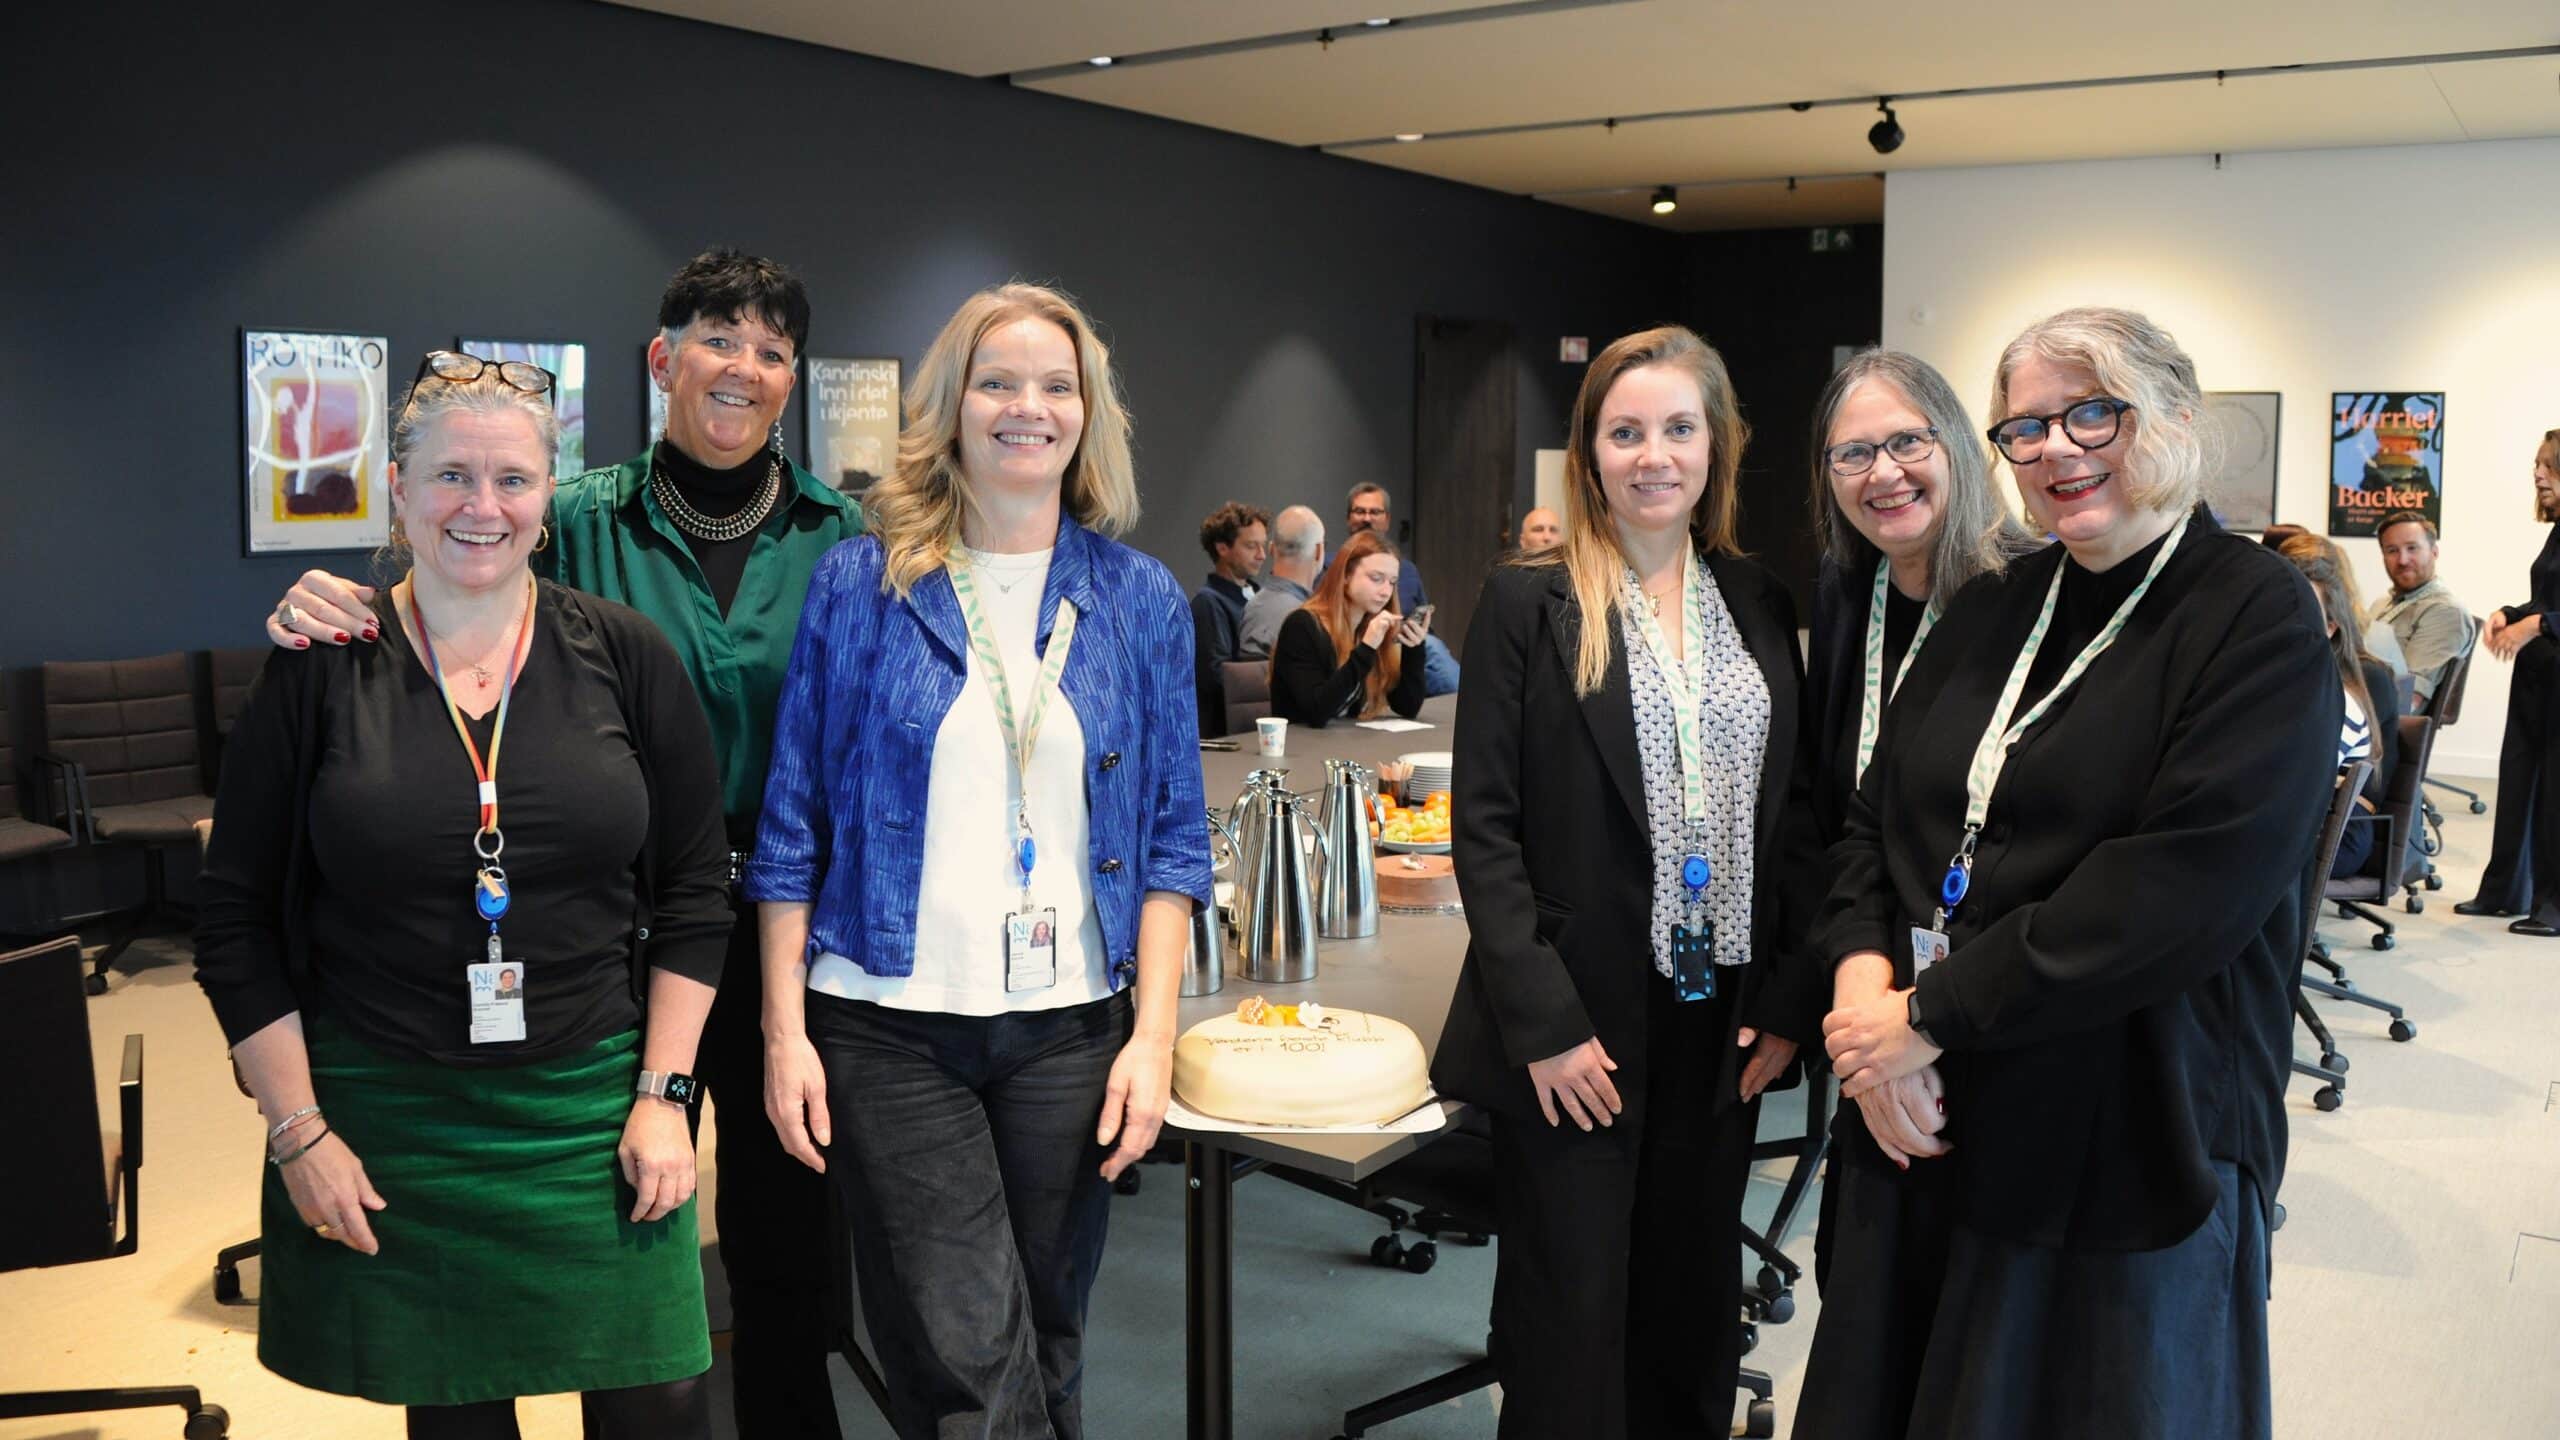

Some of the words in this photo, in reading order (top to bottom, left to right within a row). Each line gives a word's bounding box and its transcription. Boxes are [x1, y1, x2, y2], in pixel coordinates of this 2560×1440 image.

[251, 338, 383, 369] ROTHKO
[809, 361, 898, 388] Kandinskij
[858, 383, 889, 401] det
[2340, 406, 2437, 431] Harriet
[2337, 485, 2430, 509] Backer
